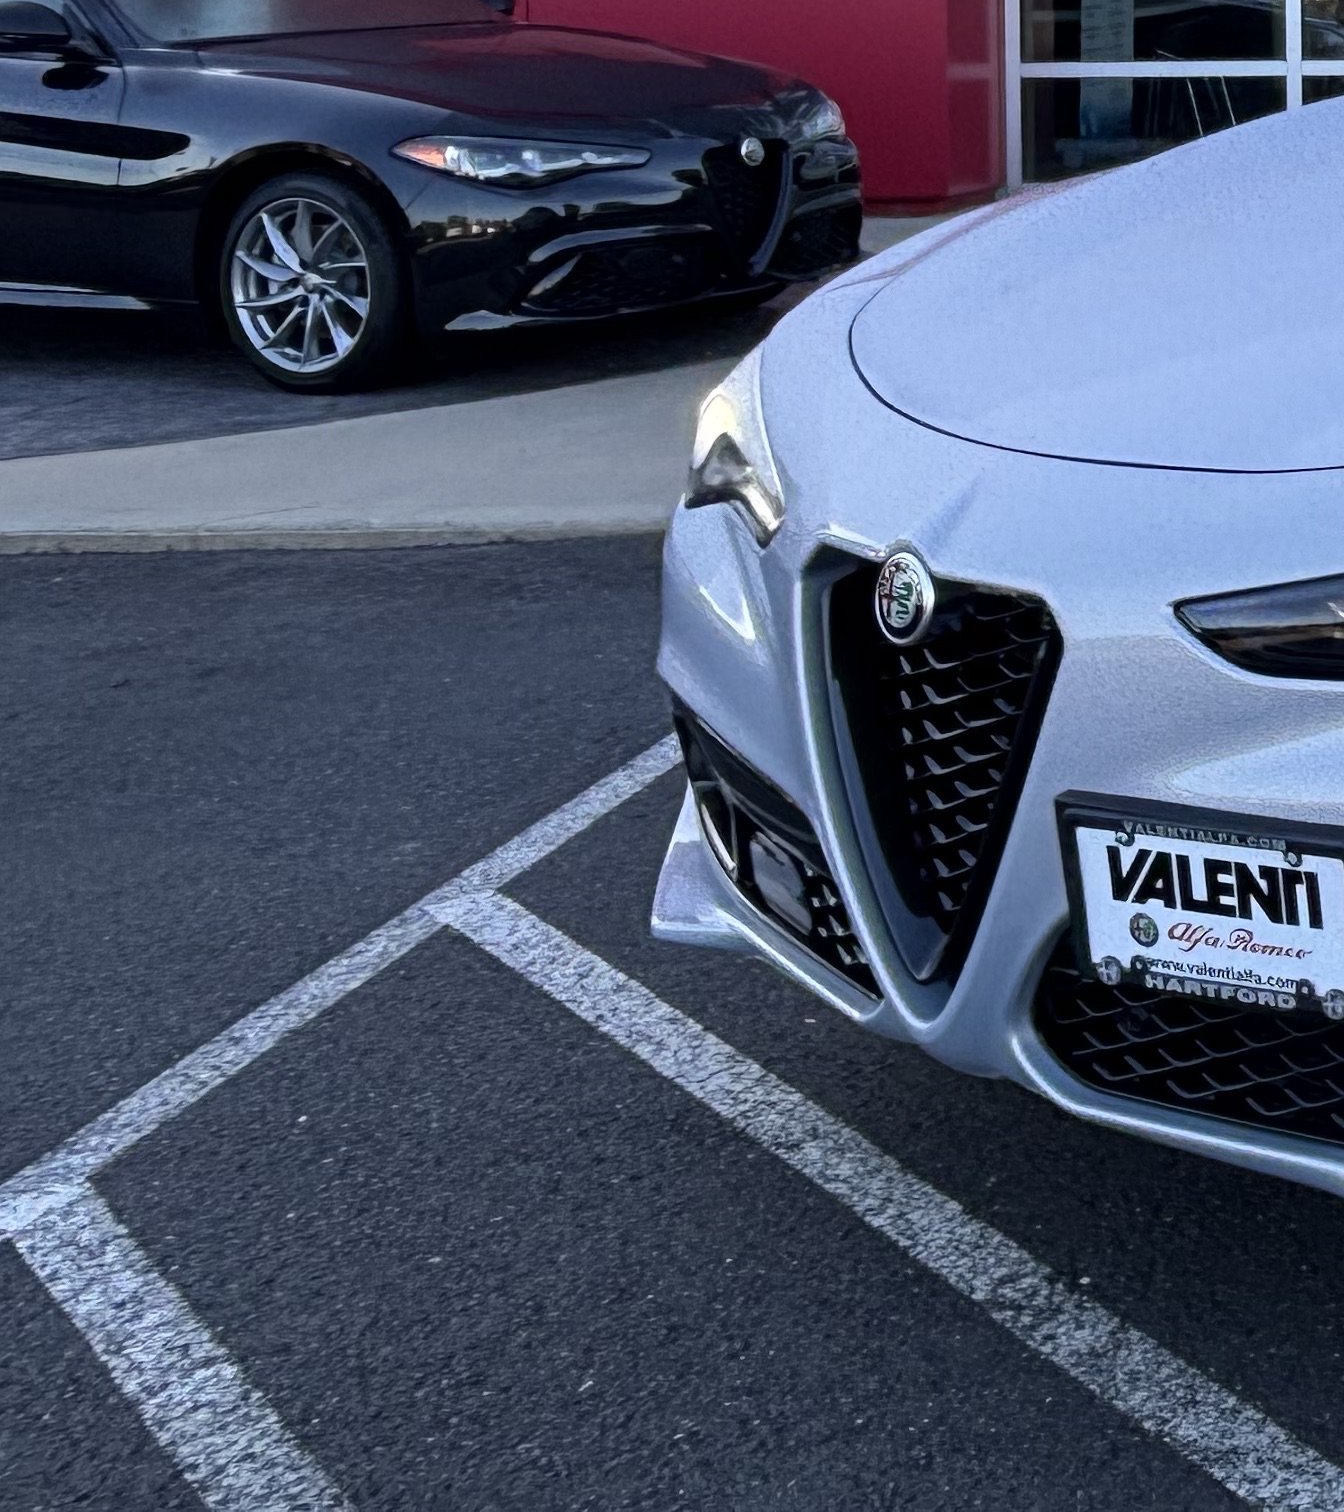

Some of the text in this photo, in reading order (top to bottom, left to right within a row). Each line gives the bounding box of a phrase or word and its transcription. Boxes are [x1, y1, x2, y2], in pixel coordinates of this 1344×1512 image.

[1105, 844, 1324, 930] VALENTI
[1167, 921, 1313, 960] Alfa Romeo
[1144, 973, 1297, 1009] HARTFORD
